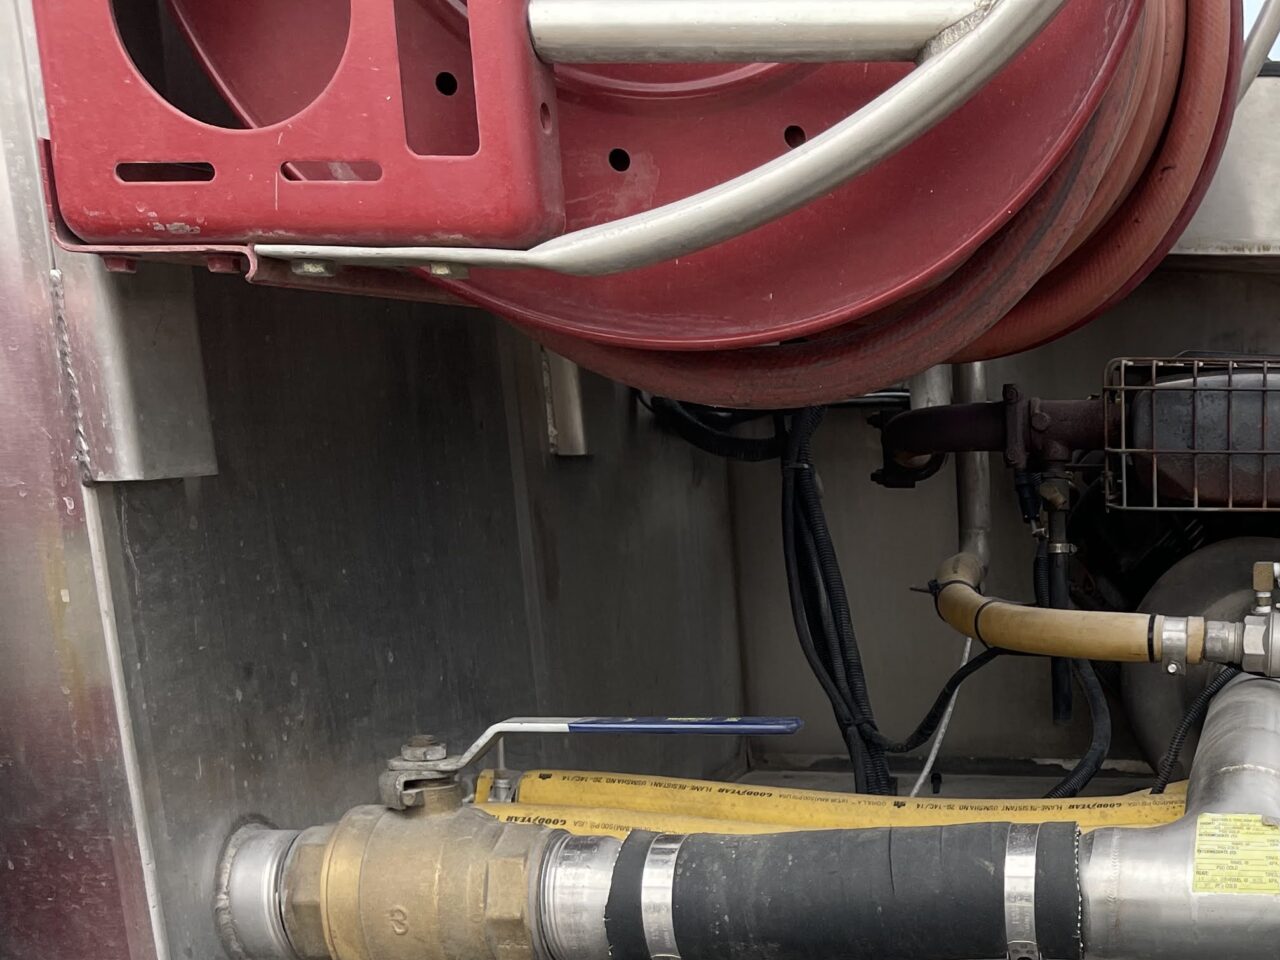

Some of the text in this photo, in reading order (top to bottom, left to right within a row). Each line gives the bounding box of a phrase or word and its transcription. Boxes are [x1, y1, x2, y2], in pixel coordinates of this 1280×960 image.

[717, 787, 773, 798] GOODYEAR
[1067, 802, 1122, 810] GOODYEAR
[505, 815, 567, 827] GOODYEAR
